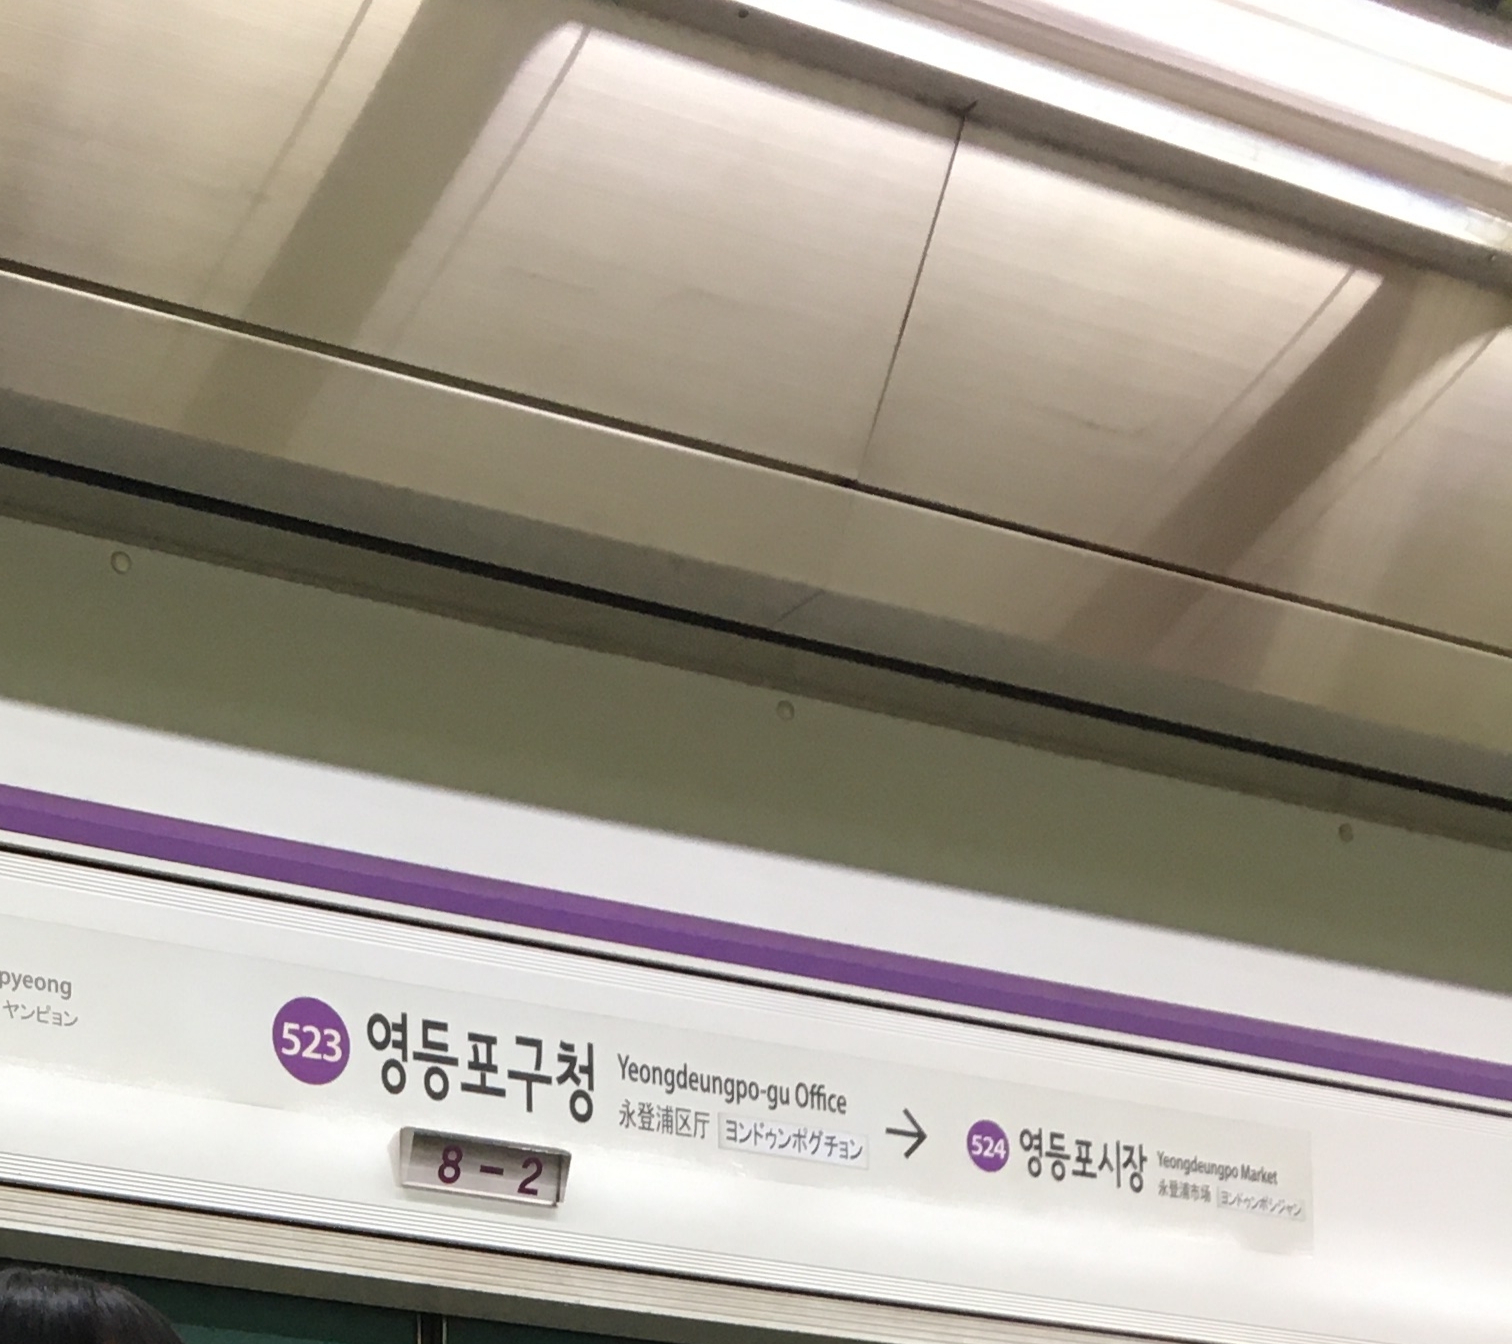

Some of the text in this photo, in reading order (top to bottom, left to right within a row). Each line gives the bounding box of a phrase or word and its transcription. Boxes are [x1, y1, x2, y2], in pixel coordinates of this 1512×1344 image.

[280, 1011, 595, 1123] 523 영등포구청
[616, 1052, 848, 1116] Yeongdeungpo-gu Office
[970, 1127, 1148, 1194] 524 영등포시장
[1156, 1150, 1279, 1186] Yeongdeungpo Market
